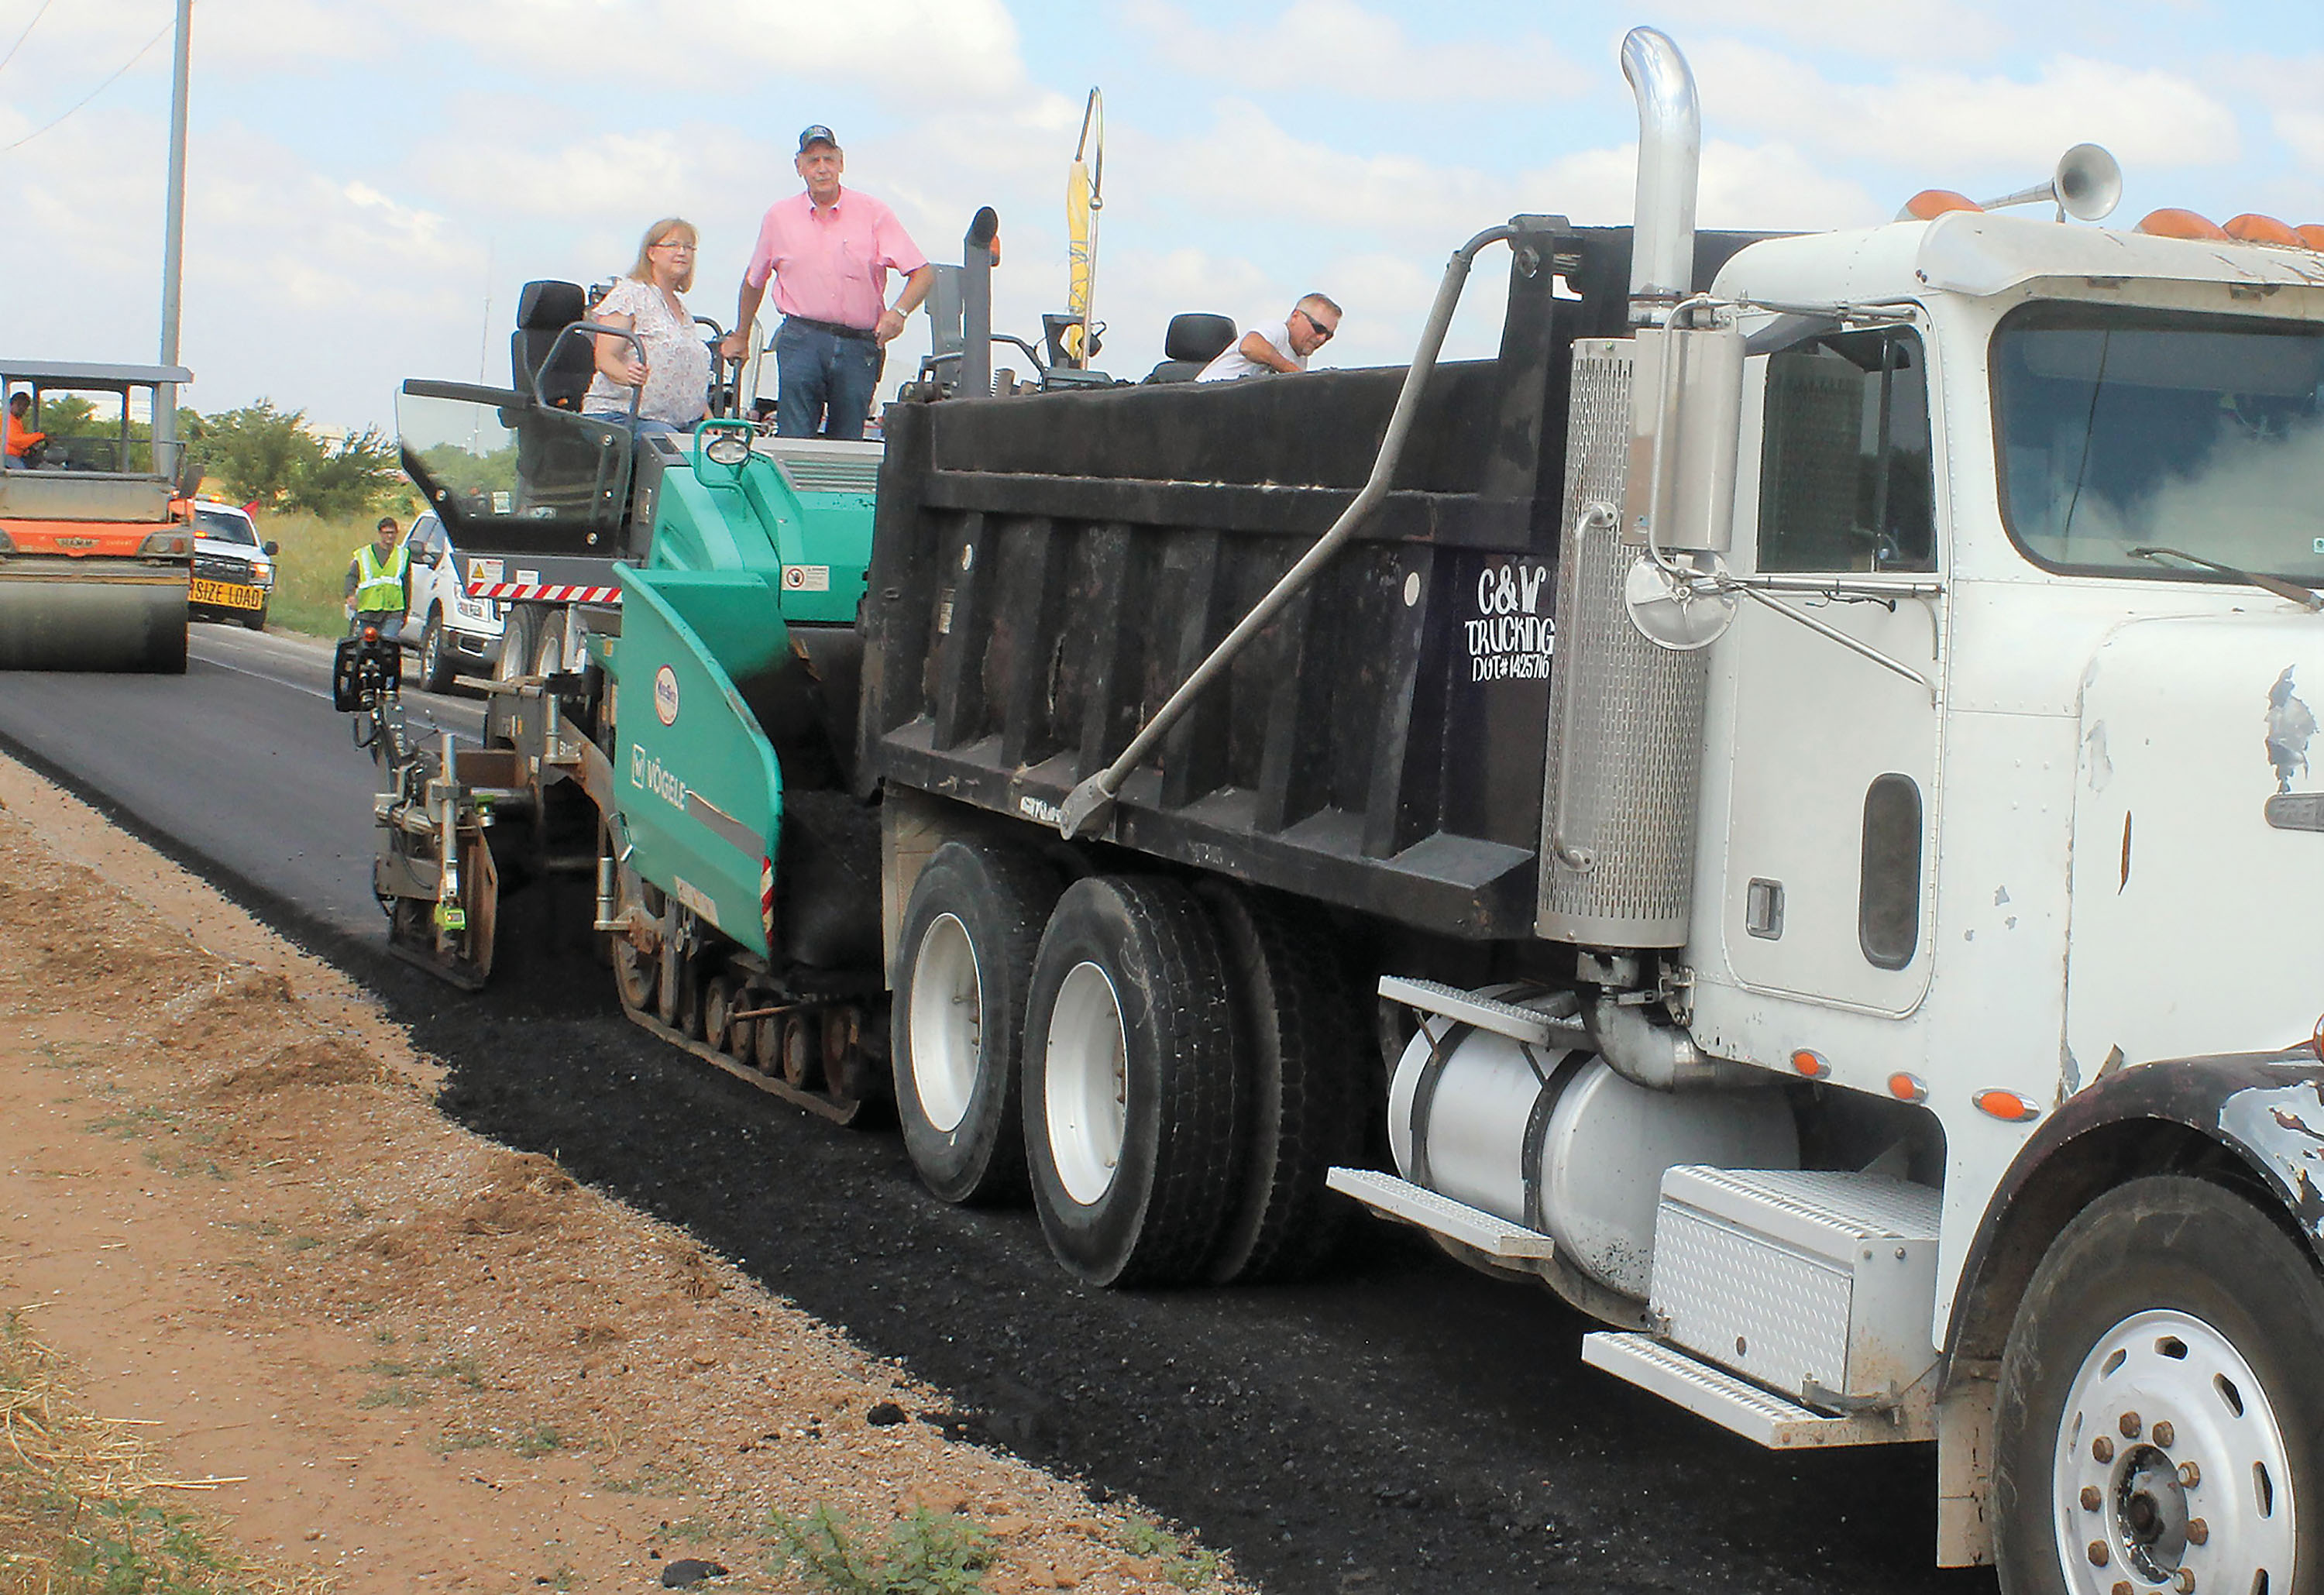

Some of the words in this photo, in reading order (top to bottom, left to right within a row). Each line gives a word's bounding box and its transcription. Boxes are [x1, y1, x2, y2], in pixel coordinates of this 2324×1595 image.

[229, 586, 260, 607] LOAD
[1478, 565, 1546, 614] C&W
[1464, 616, 1556, 655] TRUCKING
[1473, 654, 1549, 682] DOT#1425716
[647, 757, 686, 811] VÖGELE
